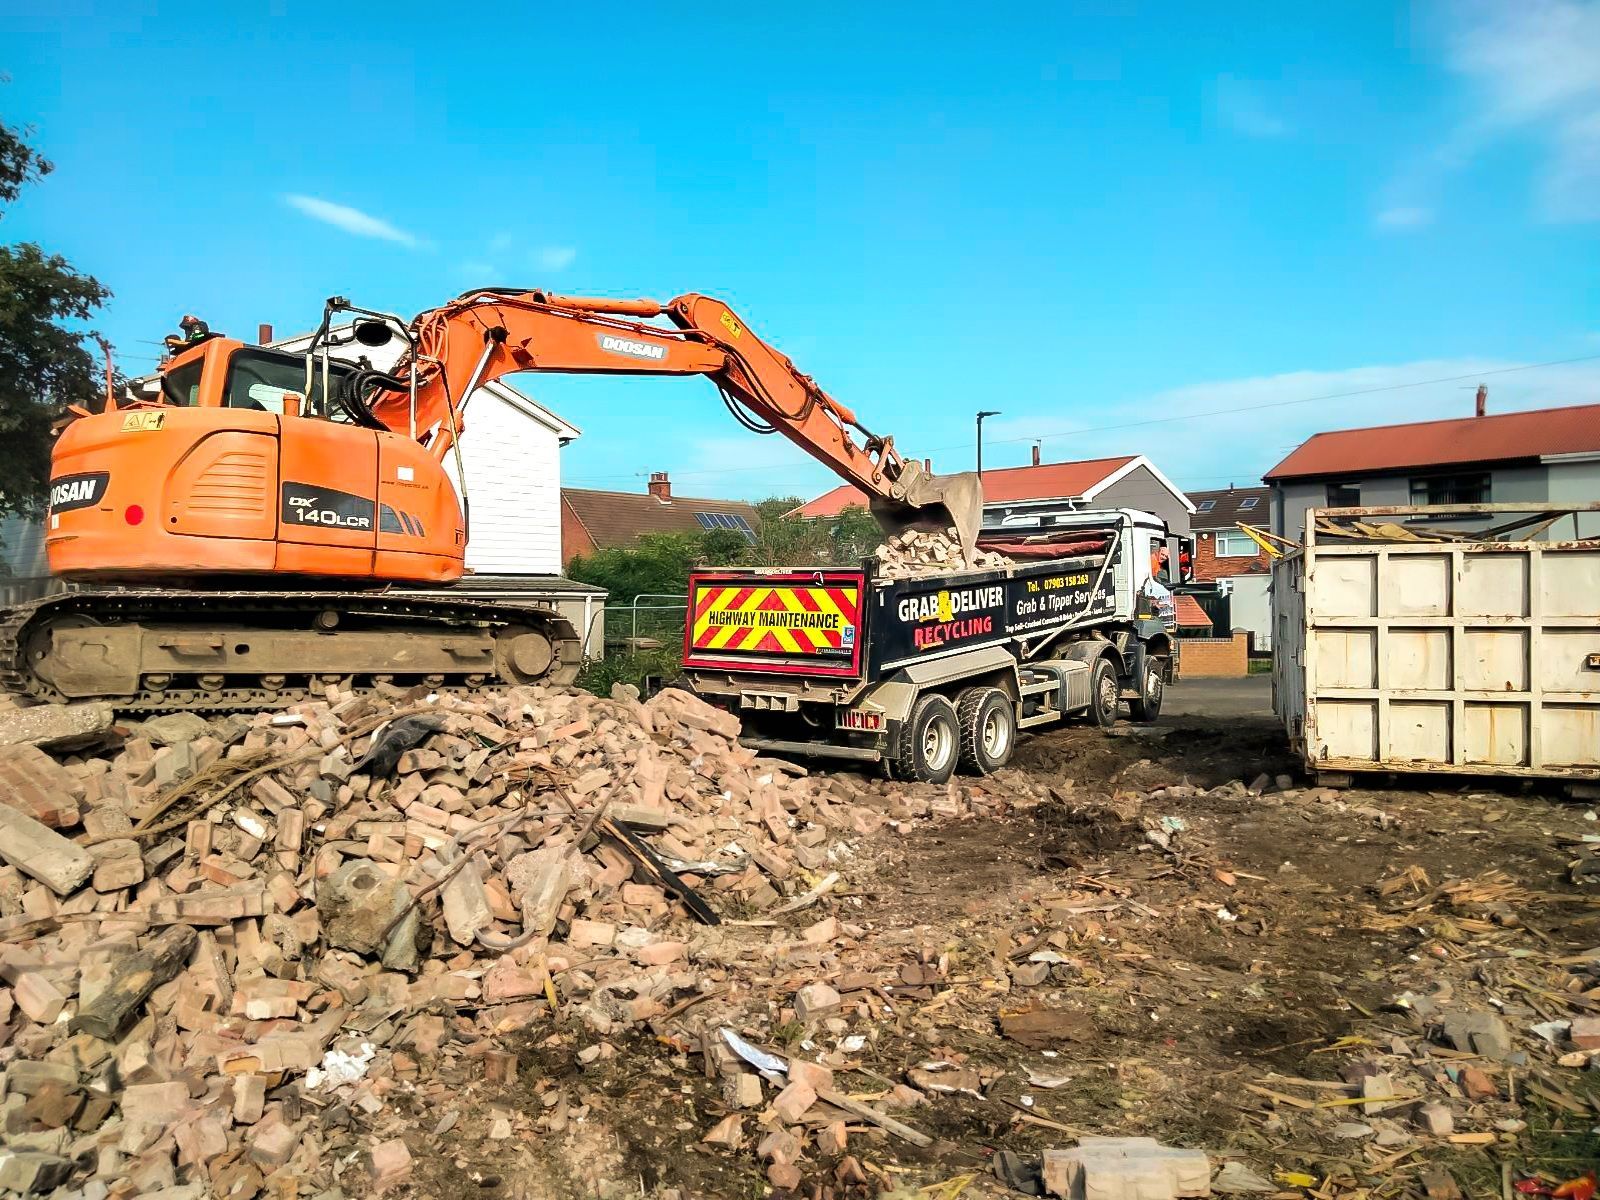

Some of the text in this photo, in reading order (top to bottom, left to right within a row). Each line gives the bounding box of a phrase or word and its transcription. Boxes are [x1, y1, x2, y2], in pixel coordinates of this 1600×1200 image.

[603, 336, 664, 359] DOOSAN
[288, 496, 319, 508] DX
[296, 507, 370, 528] 140LCR
[1027, 580, 1040, 592] Tel.
[898, 594, 941, 622] GRAB
[950, 586, 1004, 614] DELIVER
[1017, 597, 1037, 616] Grab
[1040, 596, 1046, 611] &
[1049, 594, 1073, 612] Tipper
[1074, 588, 1106, 605] Serves
[708, 610, 839, 629] HIGHWAY MAINTENANCE
[914, 615, 992, 648] RECYCLING
